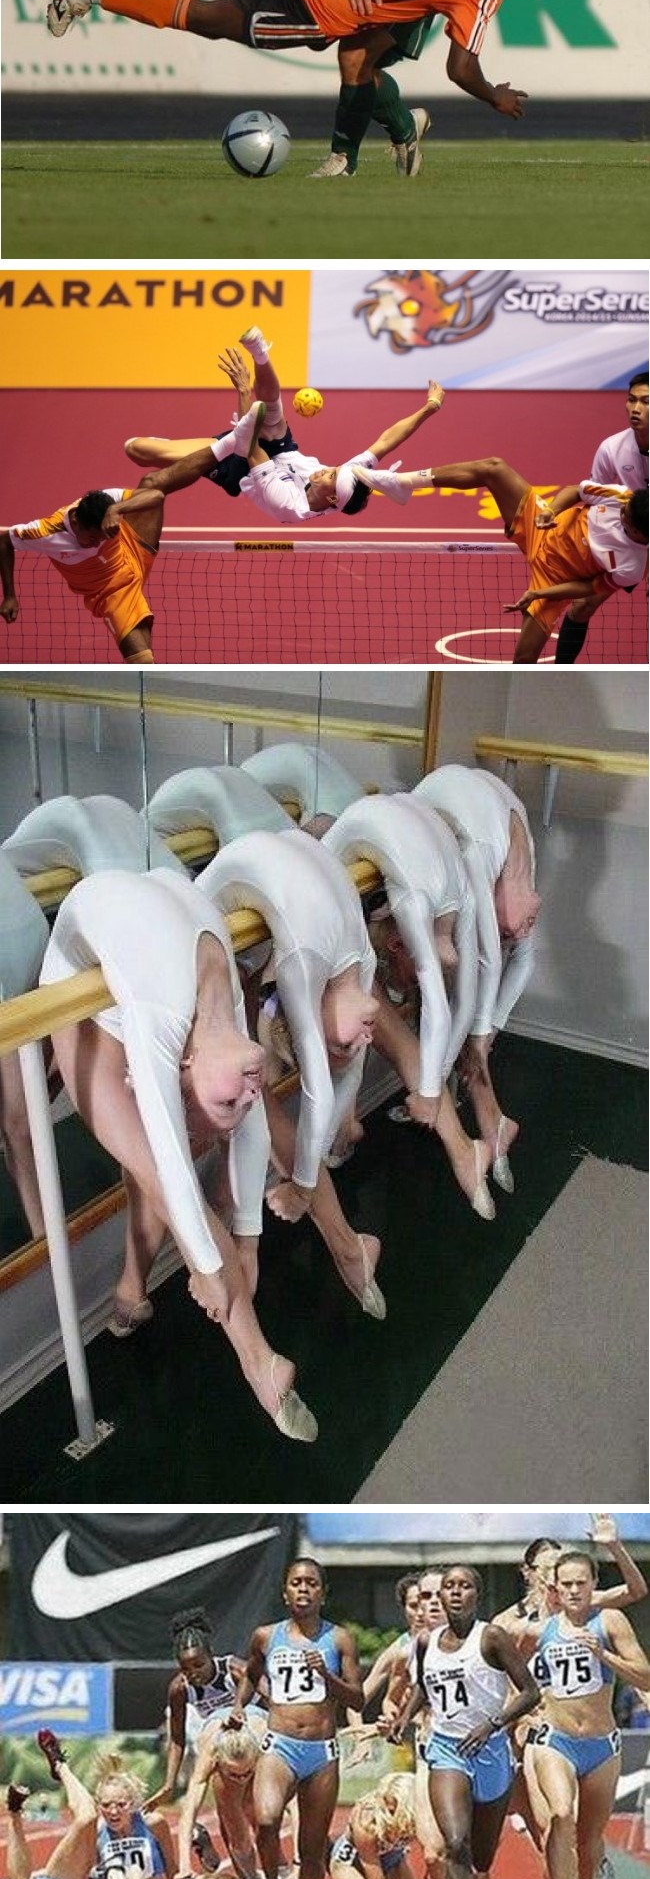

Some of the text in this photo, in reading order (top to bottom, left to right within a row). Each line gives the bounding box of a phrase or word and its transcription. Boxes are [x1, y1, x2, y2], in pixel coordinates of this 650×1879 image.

[278, 1666, 314, 1693] 73
[556, 1656, 593, 1688] 75
[434, 1680, 470, 1713] 74
